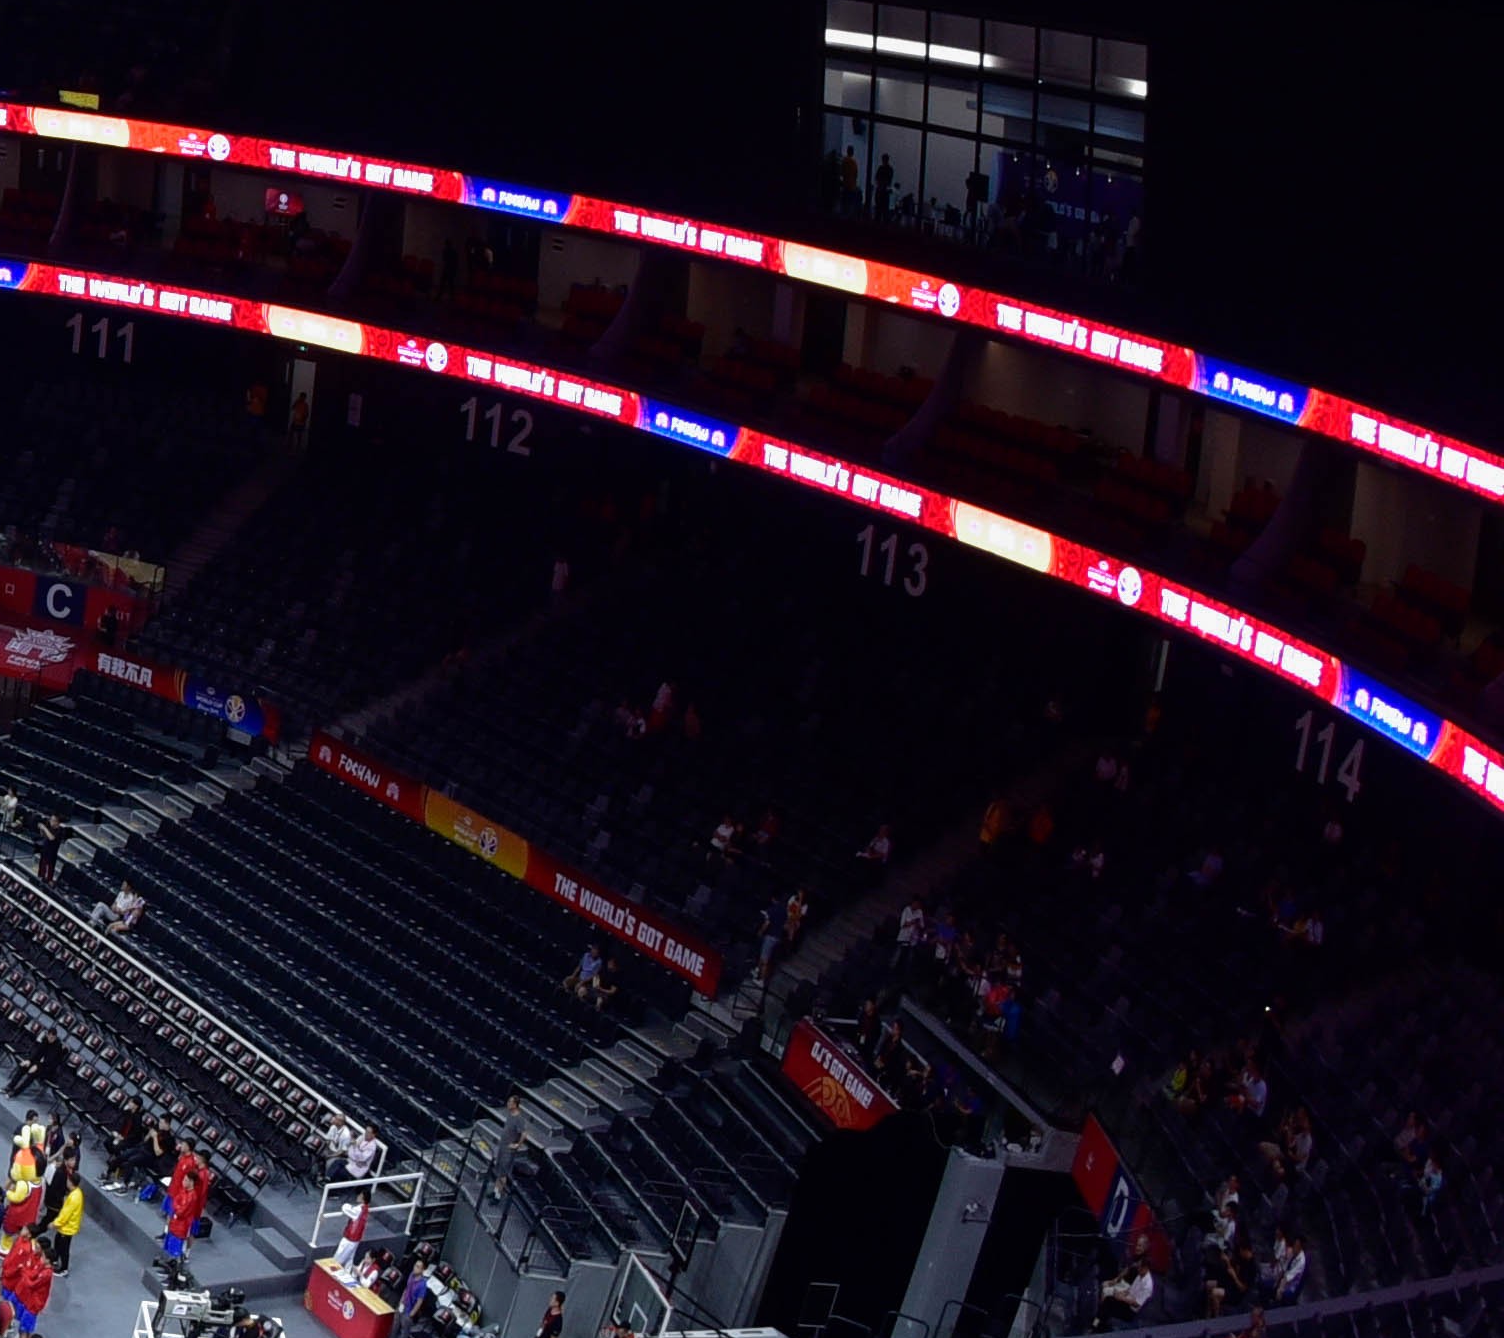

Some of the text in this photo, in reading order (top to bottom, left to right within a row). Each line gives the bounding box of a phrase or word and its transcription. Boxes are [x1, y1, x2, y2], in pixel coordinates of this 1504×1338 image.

[67, 311, 137, 362] 111
[460, 399, 534, 456] 112
[857, 524, 930, 597] 113
[46, 583, 73, 619] C
[98, 652, 153, 689] 有我不凡
[1294, 710, 1364, 802] 114
[553, 872, 705, 978] THE WORLD'S GOT GAME
[828, 1055, 848, 1089] GOT
